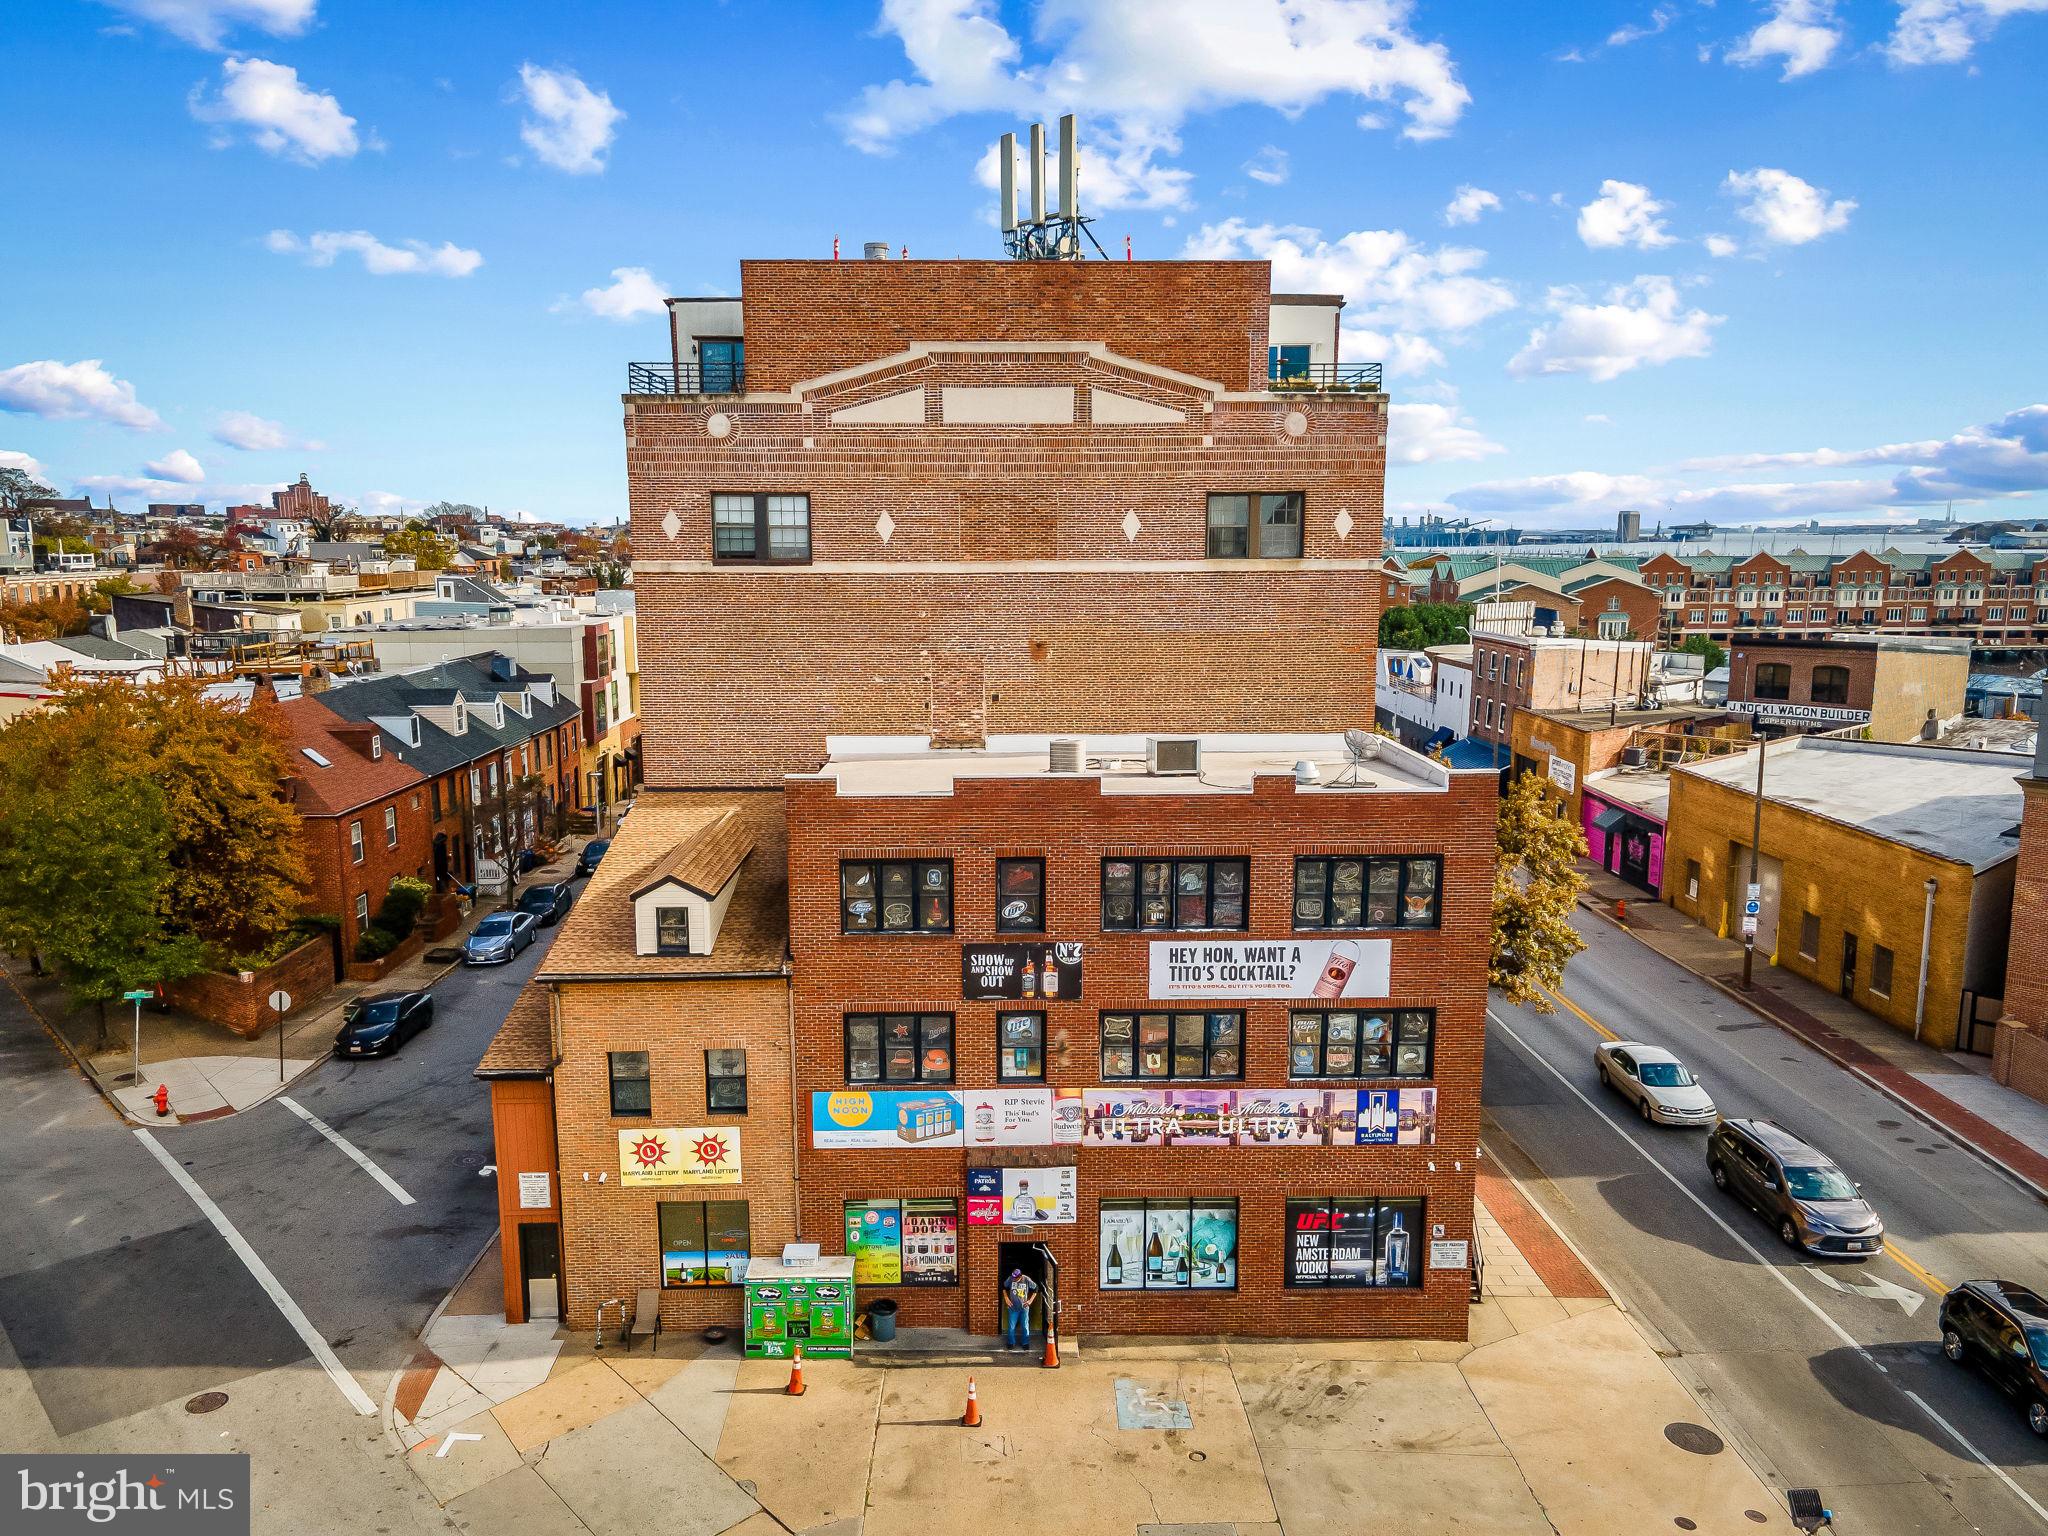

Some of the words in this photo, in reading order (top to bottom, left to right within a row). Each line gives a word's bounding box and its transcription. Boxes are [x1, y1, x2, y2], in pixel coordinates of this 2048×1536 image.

[1778, 704, 1818, 717] WAGON
[1820, 708, 1870, 721] BUILDER
[970, 954, 1005, 966] SHOW
[1004, 958, 1014, 966] UP
[1169, 947, 1198, 963] HEY
[1203, 947, 1238, 964] HON,
[1244, 946, 1286, 962] WANT
[1291, 946, 1301, 963] A
[970, 966, 984, 974] AND
[985, 966, 1014, 976] SHOW
[1168, 966, 1215, 982] TITO'S
[1220, 965, 1296, 981] COCKTAIL?
[980, 976, 1005, 988] OUT
[1020, 1098, 1046, 1106] Stevie
[1101, 1117, 1184, 1134] ULTRA
[1218, 1117, 1298, 1134] ULTRA
[904, 1218, 954, 1226] LOADING
[1296, 1213, 1345, 1230] UFC
[912, 1226, 948, 1234] DOCK
[1296, 1235, 1320, 1247] NEW
[725, 1252, 745, 1260] SALE
[918, 1256, 954, 1264] MONUMENT
[1296, 1248, 1361, 1261] AMSTERDAM
[1296, 1262, 1329, 1274] VODKA
[767, 1346, 783, 1354] IPA
